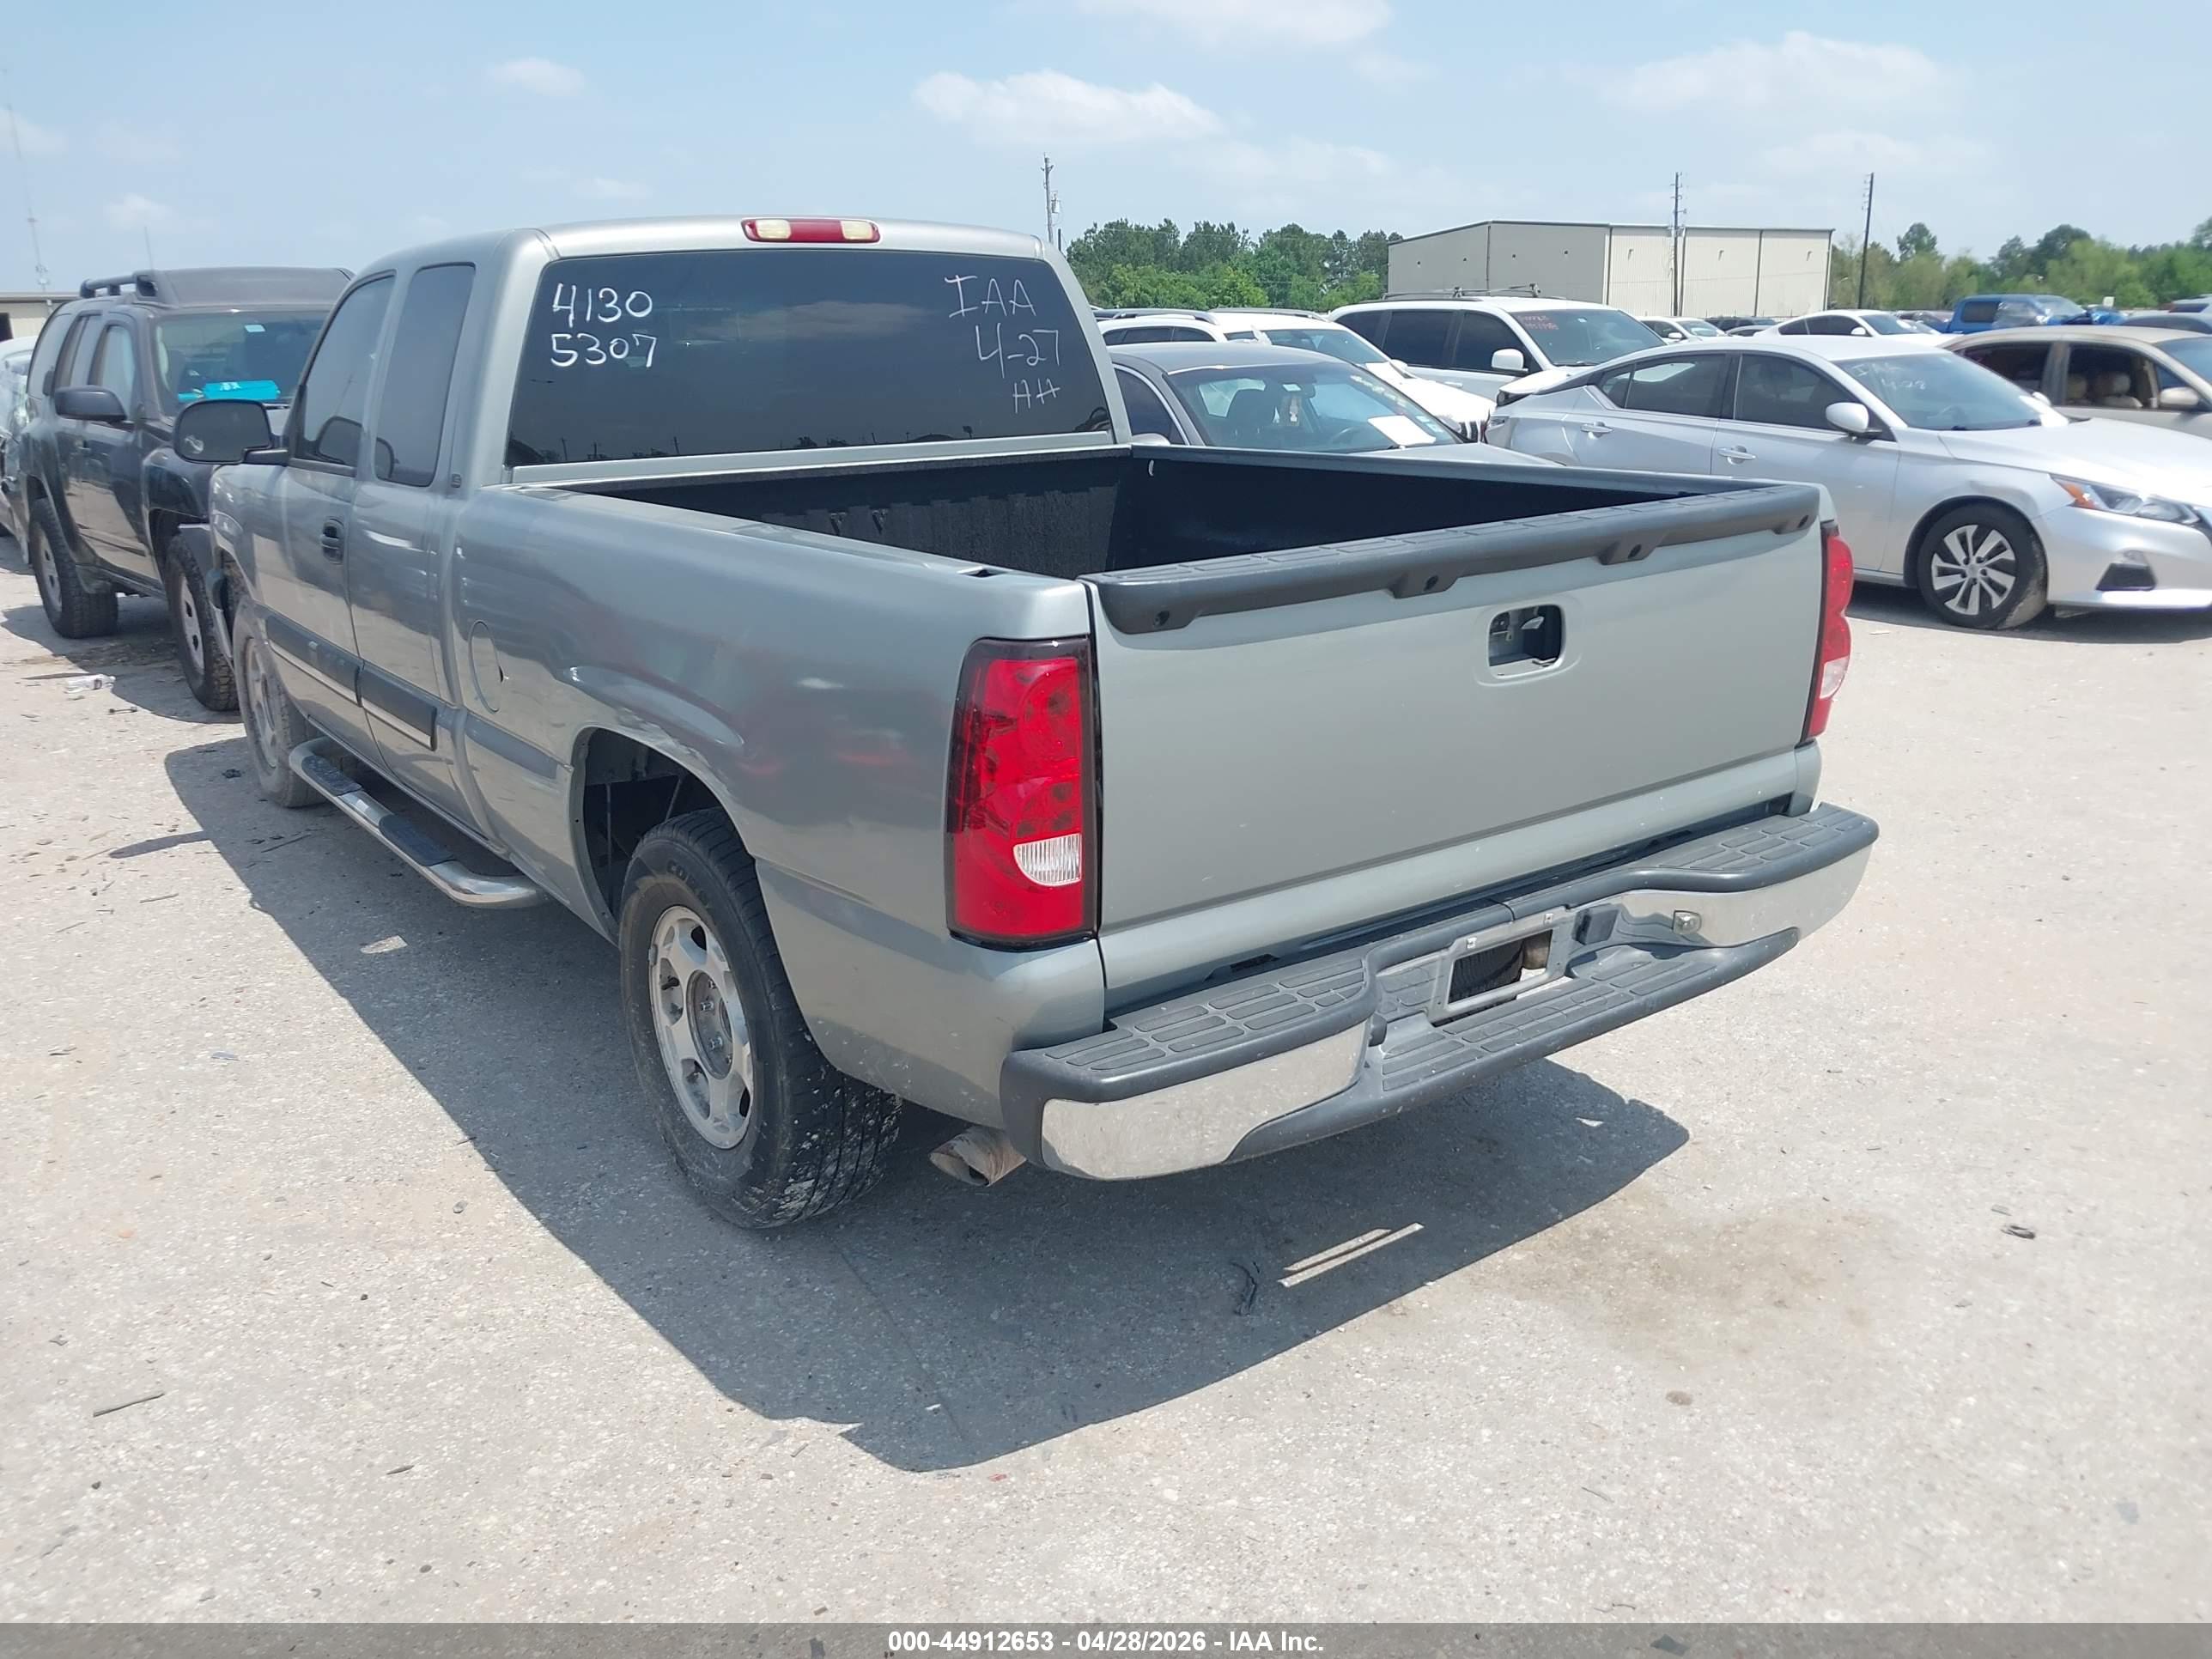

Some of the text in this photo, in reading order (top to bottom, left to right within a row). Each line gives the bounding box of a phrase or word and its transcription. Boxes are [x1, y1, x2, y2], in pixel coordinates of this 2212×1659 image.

[552, 283, 653, 328] 4130
[944, 274, 1036, 319] IAA
[550, 332, 657, 368] 5307
[975, 322, 1060, 379] 4-27
